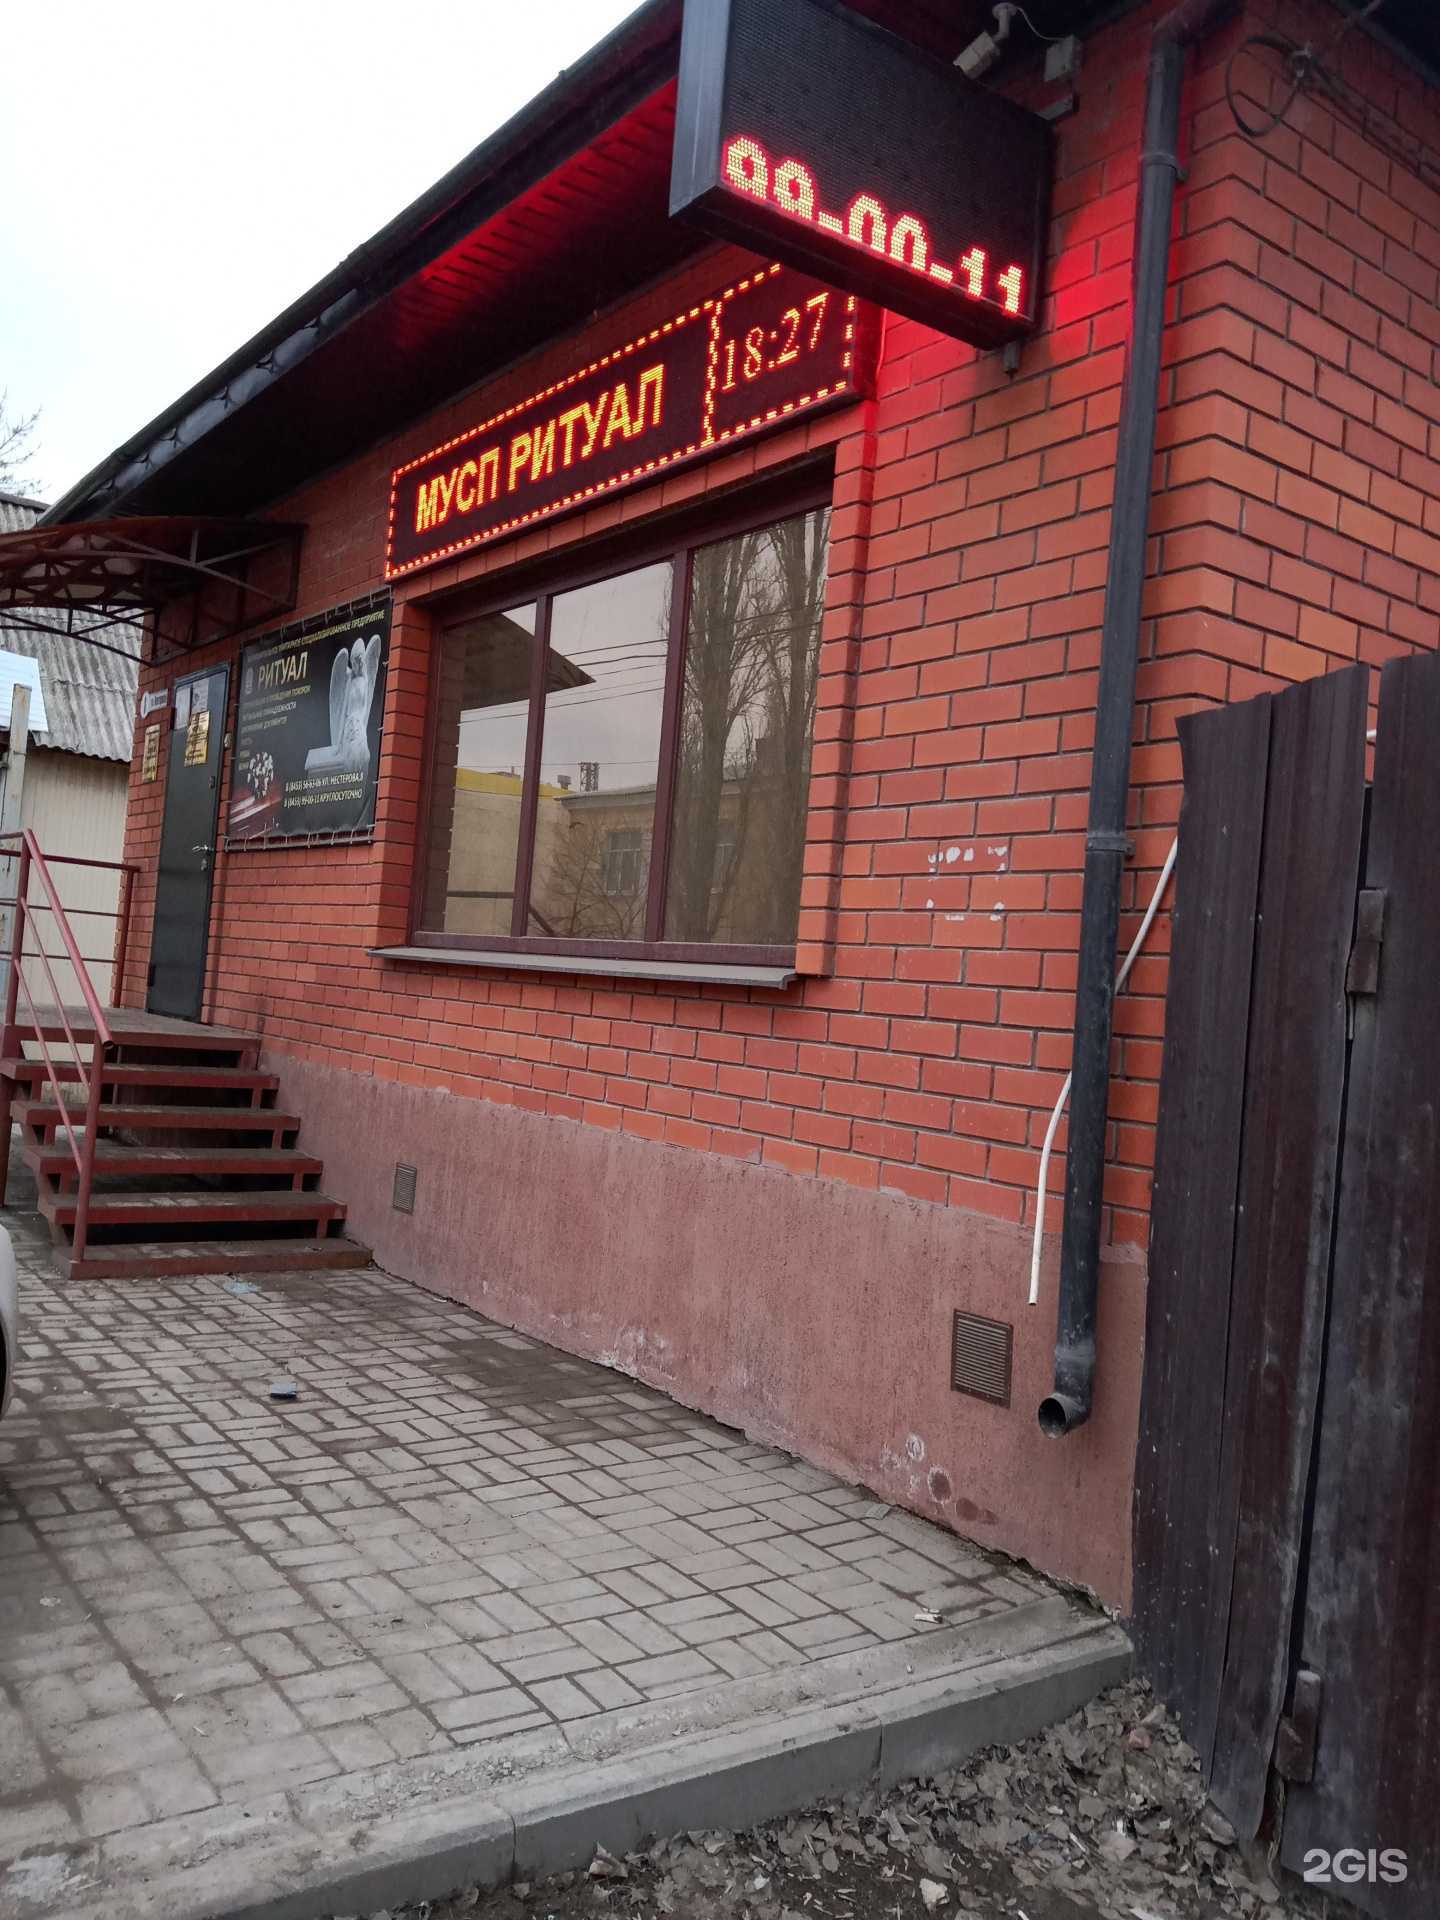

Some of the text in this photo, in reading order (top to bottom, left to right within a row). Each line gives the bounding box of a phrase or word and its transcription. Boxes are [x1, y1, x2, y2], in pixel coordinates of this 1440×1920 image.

[722, 292, 830, 393] 18:27
[414, 362, 666, 534] МУСП РИТУАЛ
[257, 650, 308, 690] РИТУАЛ
[319, 788, 363, 804] КРУГЛОСУТОЧНО
